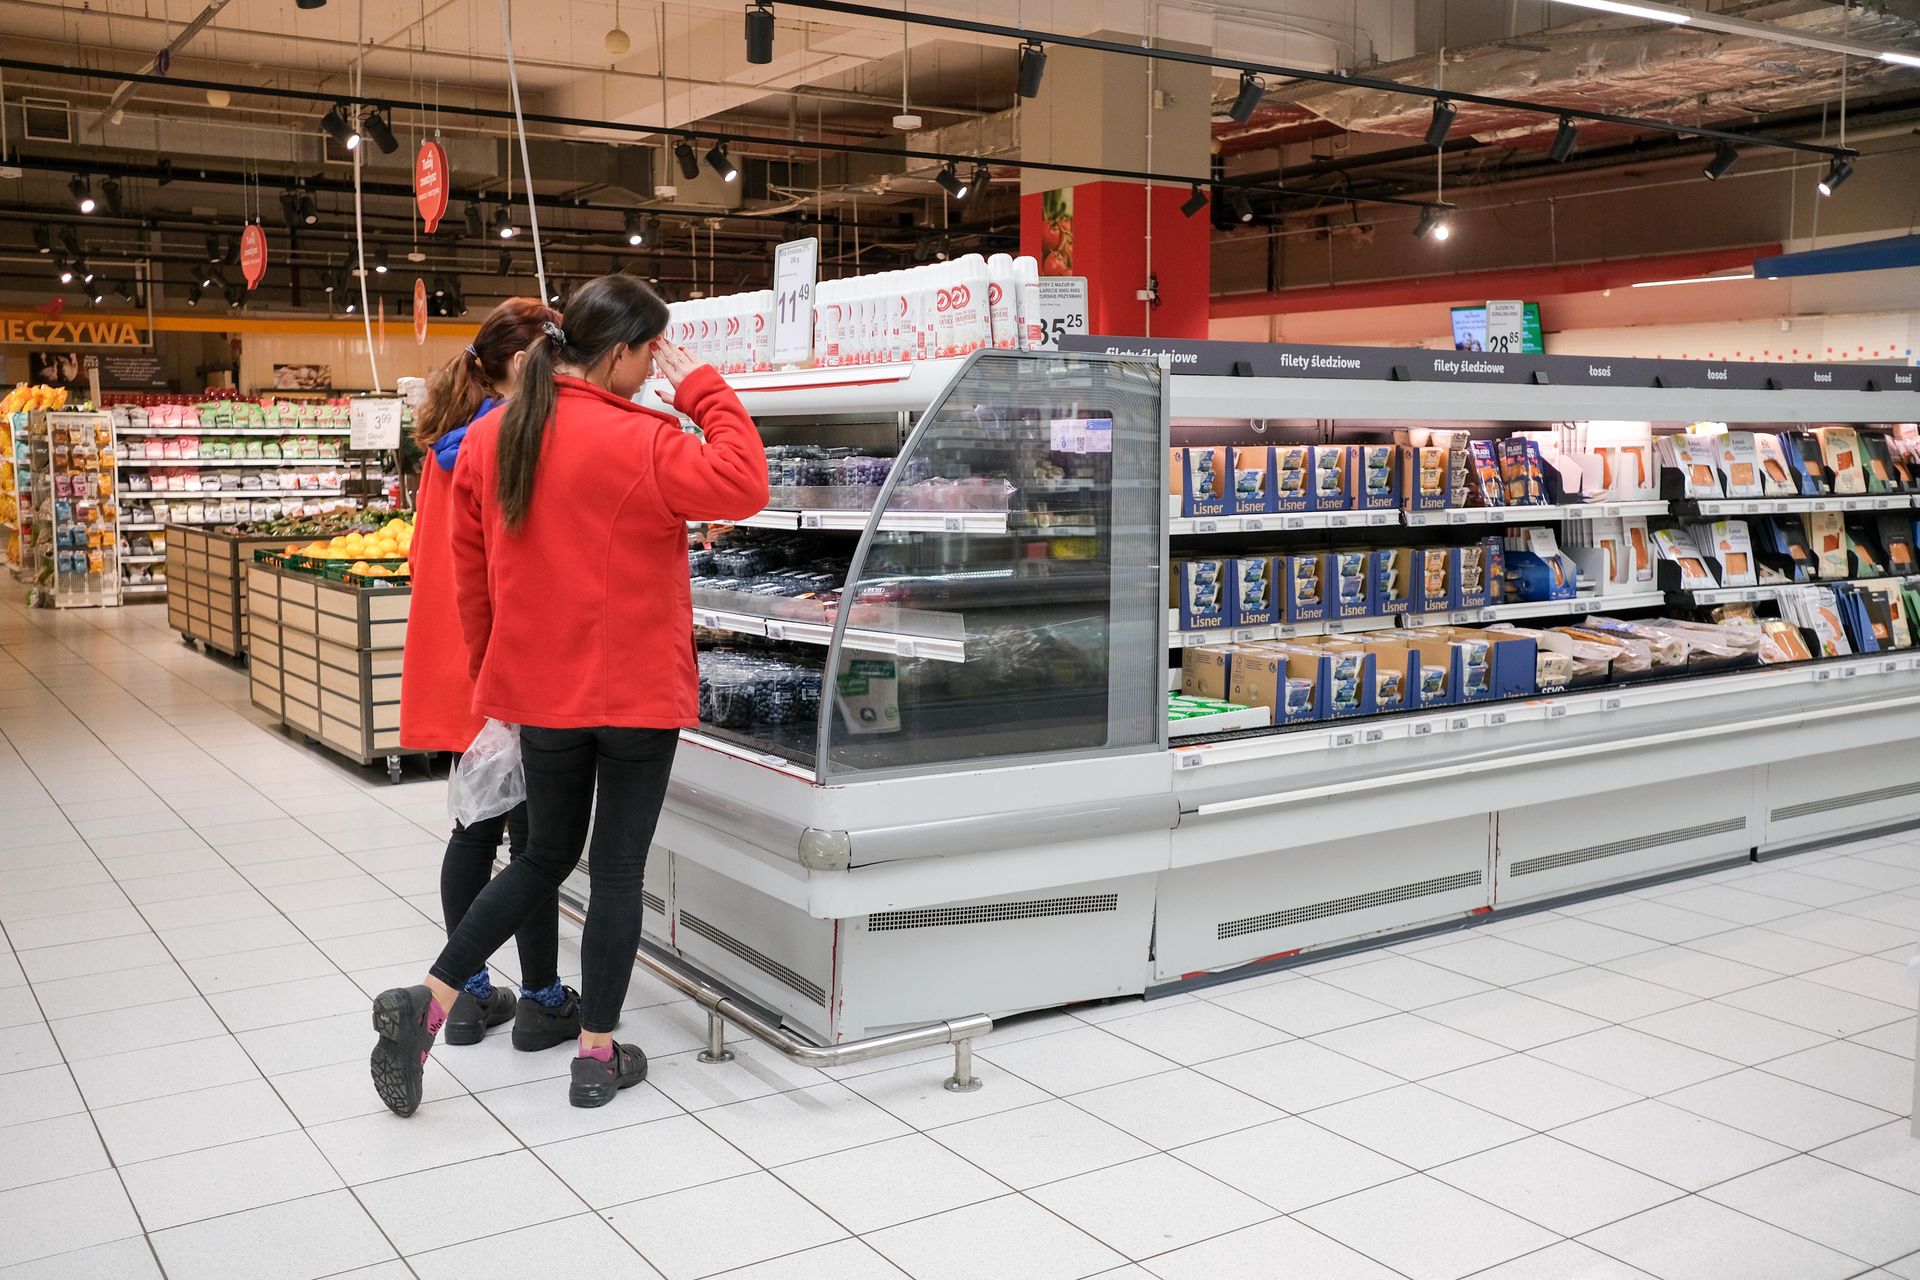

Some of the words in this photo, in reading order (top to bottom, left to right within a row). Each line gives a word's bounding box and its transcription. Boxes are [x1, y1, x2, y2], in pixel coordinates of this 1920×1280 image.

[778, 290, 797, 324] 11
[799, 283, 810, 300] 49
[1066, 314, 1083, 328] 25
[0, 319, 140, 345] IECZYWA
[1509, 331, 1519, 343] 85
[1280, 353, 1310, 371] filety
[1311, 354, 1361, 369] śledziowe
[1433, 359, 1460, 375] filety
[1460, 360, 1505, 374] śledziowe
[1589, 364, 1611, 377] łosoś
[1707, 368, 1727, 380] łosoś
[1813, 371, 1832, 383] łosoś
[1894, 373, 1912, 384] łosoś
[374, 415, 382, 430] 3
[1236, 500, 1266, 513] Lisner
[1278, 499, 1307, 511] Lisner
[1316, 497, 1344, 510] Lisner
[1366, 496, 1393, 508] Lisner
[1420, 497, 1445, 509] Lisner
[1193, 503, 1224, 515] Lisner
[1382, 600, 1409, 613] Lisner
[1424, 599, 1449, 611] Lisner
[1462, 595, 1486, 608] Lisner
[1296, 607, 1323, 620] Lisner
[1339, 604, 1367, 617] Lisner
[1190, 615, 1223, 628] Lisner
[1240, 611, 1271, 625] Lisner
